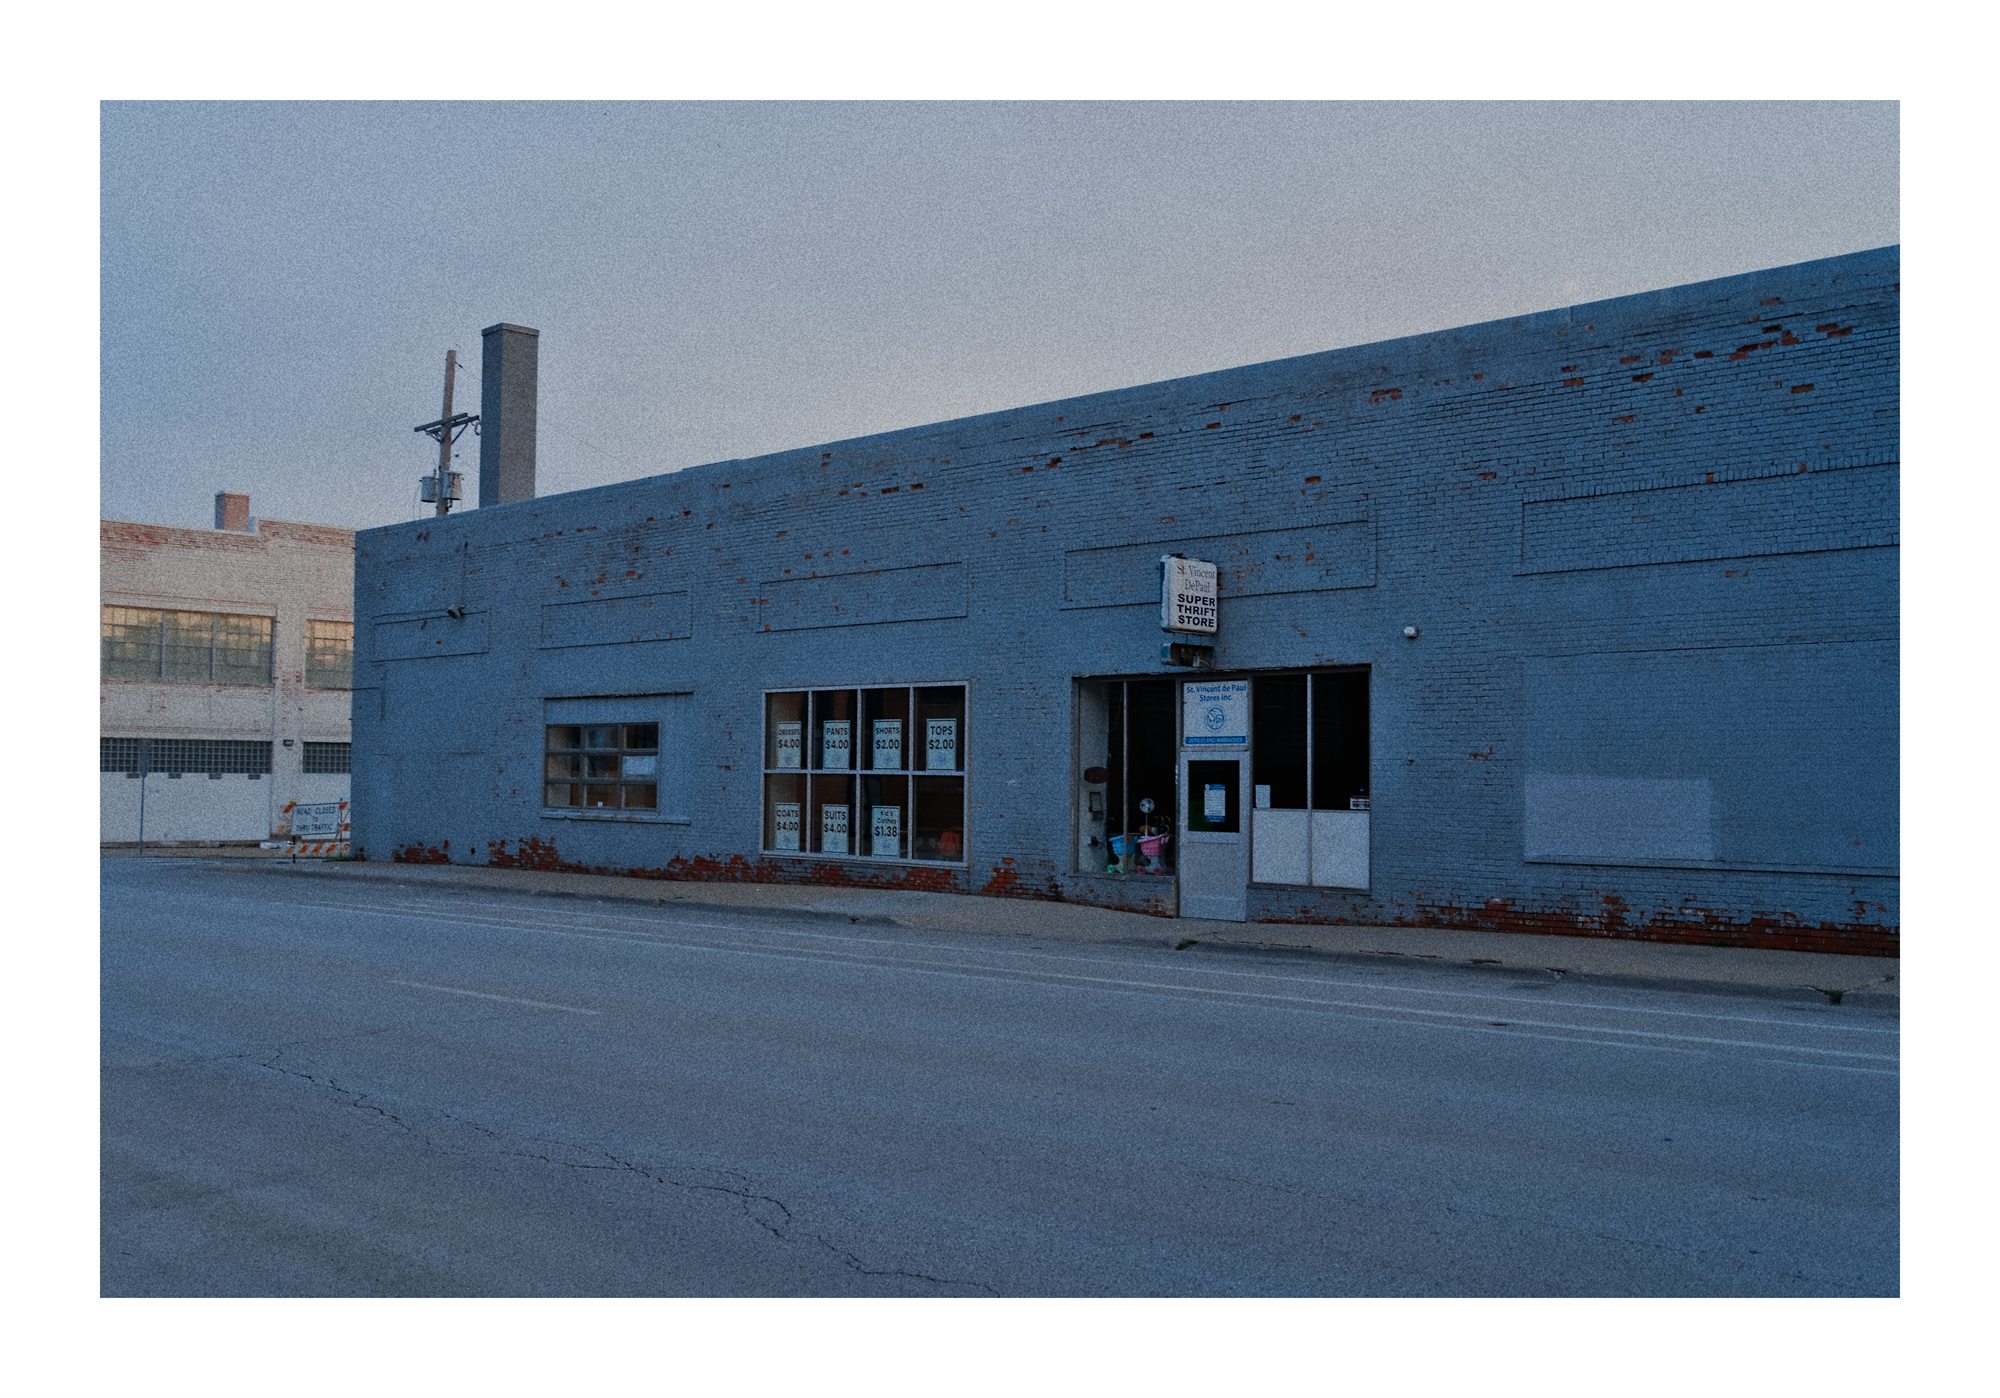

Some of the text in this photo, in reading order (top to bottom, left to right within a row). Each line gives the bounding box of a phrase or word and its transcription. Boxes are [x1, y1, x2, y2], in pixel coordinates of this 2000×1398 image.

[1178, 594, 1215, 607] SUPER
[1177, 604, 1216, 617] THRIFT
[1178, 615, 1215, 628] STORE
[1231, 684, 1246, 692] Paul
[826, 727, 849, 736] PANTS
[875, 726, 900, 735] SHORTS
[930, 726, 953, 736] TOPS
[778, 739, 800, 749] $4.00
[825, 739, 849, 750] $4.00
[875, 739, 900, 750] $2.00
[929, 739, 954, 750] $2.00
[776, 809, 799, 818] COATS
[824, 810, 847, 821] SUITS
[776, 821, 799, 832] $4.00
[823, 823, 847, 834] $4.00
[874, 825, 898, 838] $1.38
